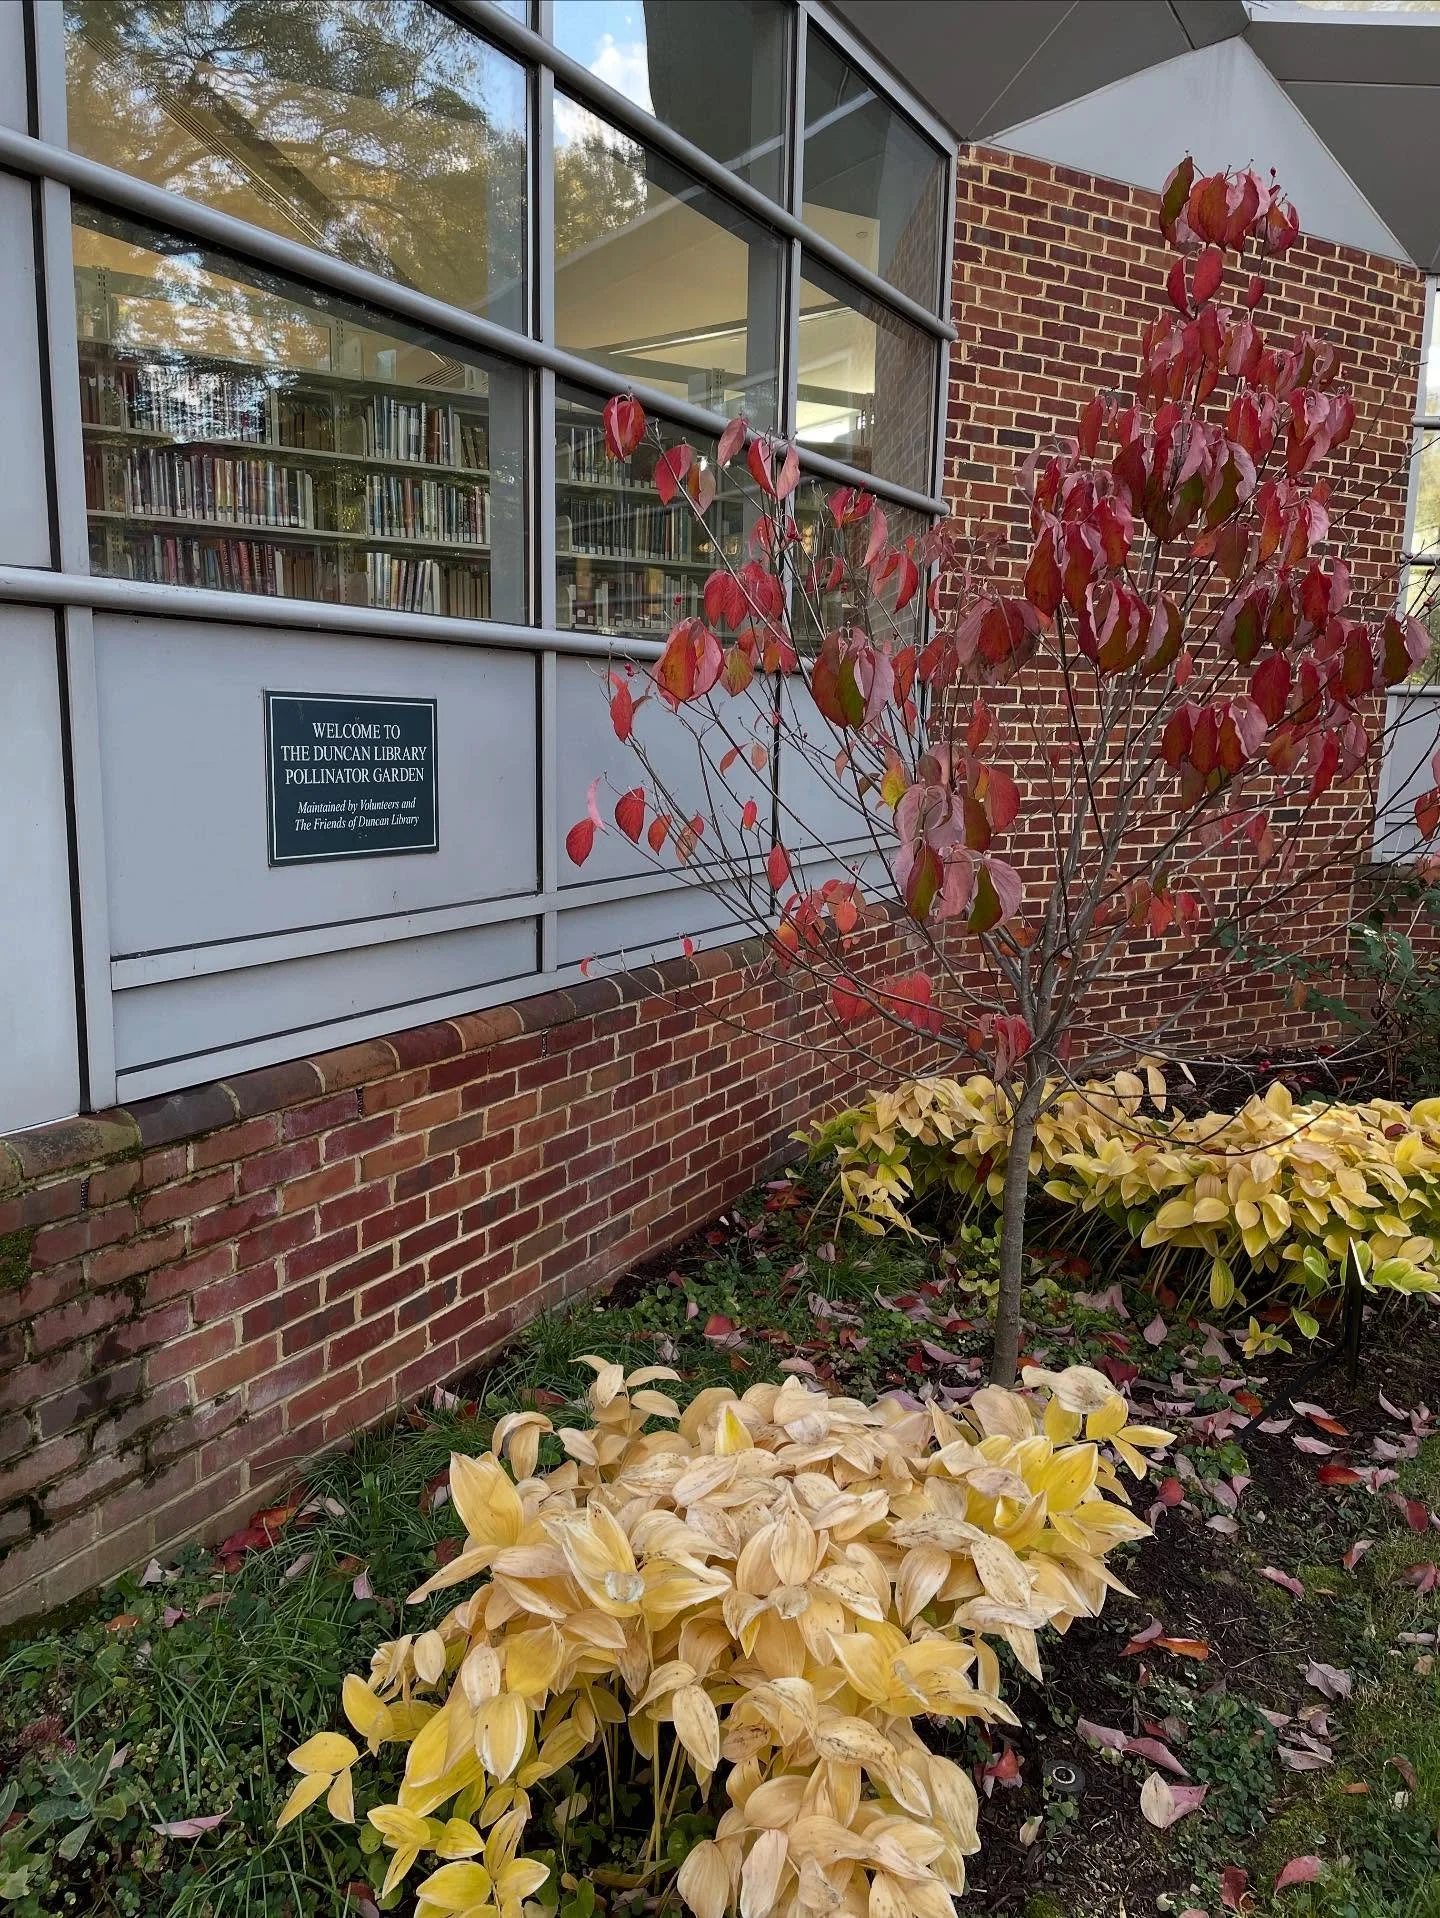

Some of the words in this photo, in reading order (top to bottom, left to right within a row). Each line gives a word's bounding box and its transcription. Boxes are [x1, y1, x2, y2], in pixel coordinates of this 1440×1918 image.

[312, 723, 380, 739] WELCOME
[384, 724, 401, 739] TO
[281, 745, 310, 761] THE
[313, 745, 371, 761] DUNCAN
[374, 746, 427, 761] LIBRARY
[285, 768, 370, 785] POLLINATOR
[373, 767, 424, 783] GARDEN
[297, 800, 346, 814] Maintained
[347, 800, 358, 814] by
[360, 798, 400, 811] Volunteers
[401, 797, 417, 809] and
[294, 818, 311, 831] The
[313, 817, 346, 830] Friends
[348, 816, 359, 830] of
[358, 815, 389, 827] Duncan
[391, 813, 420, 826] Library
